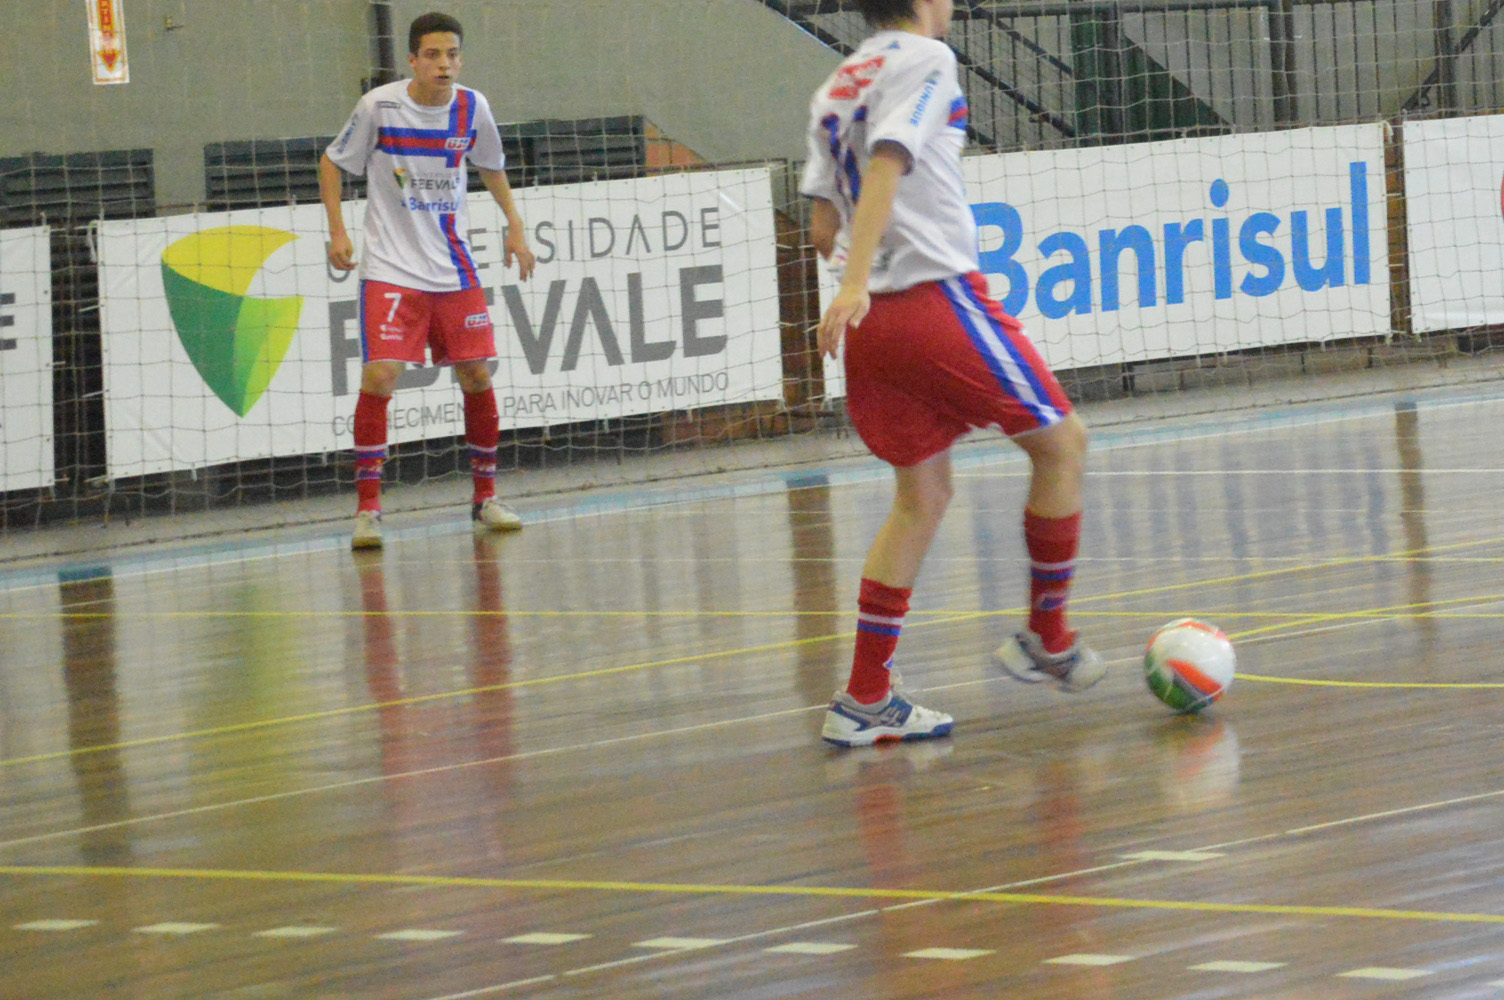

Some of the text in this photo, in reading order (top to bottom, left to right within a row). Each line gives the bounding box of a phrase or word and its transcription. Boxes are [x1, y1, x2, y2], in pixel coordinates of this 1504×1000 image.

[970, 160, 1372, 320] Banrisul
[328, 264, 729, 397] FVALE
[384, 292, 402, 323] 7
[503, 392, 557, 417] PARA
[562, 382, 633, 410] INOVAR
[638, 380, 650, 400] O
[656, 372, 730, 398] MUNDO
